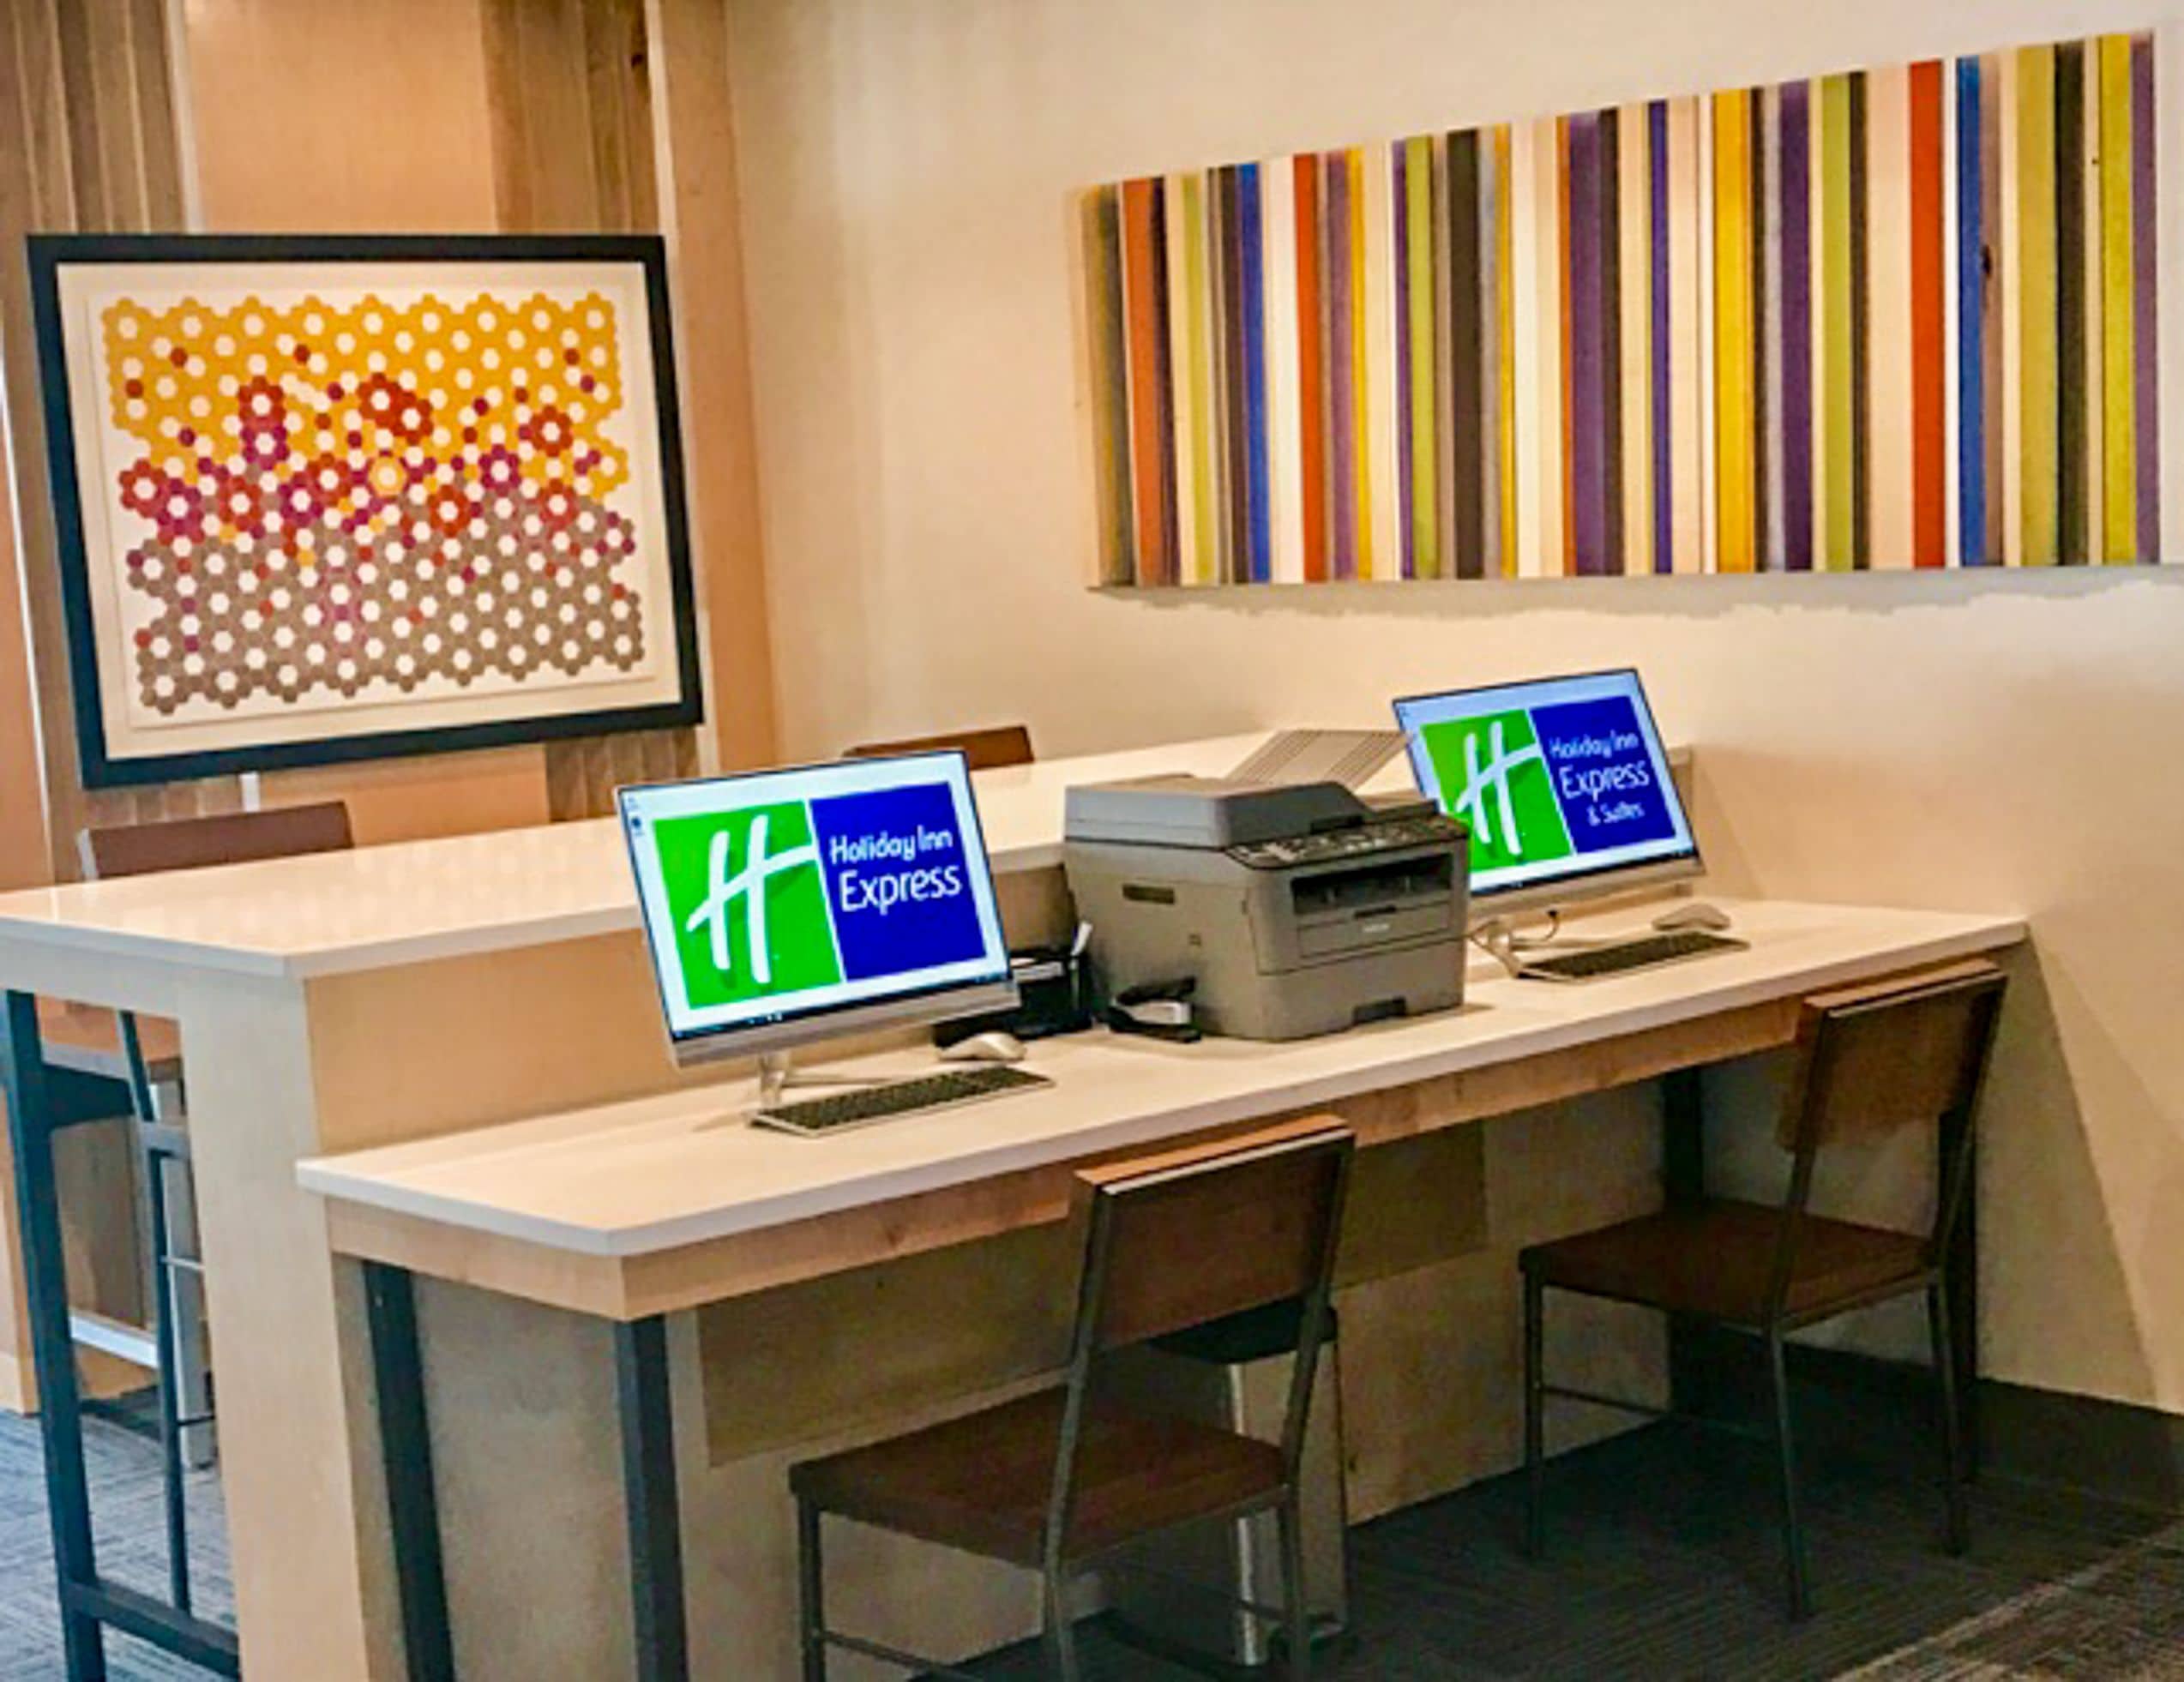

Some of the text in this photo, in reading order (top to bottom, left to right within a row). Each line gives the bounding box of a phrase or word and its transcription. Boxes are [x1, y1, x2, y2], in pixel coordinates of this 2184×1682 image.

[1549, 730, 1639, 760] Holiday Inn
[1559, 760, 1650, 802] Express
[828, 825, 954, 865] Holiday Inn
[838, 863, 962, 915] Express
